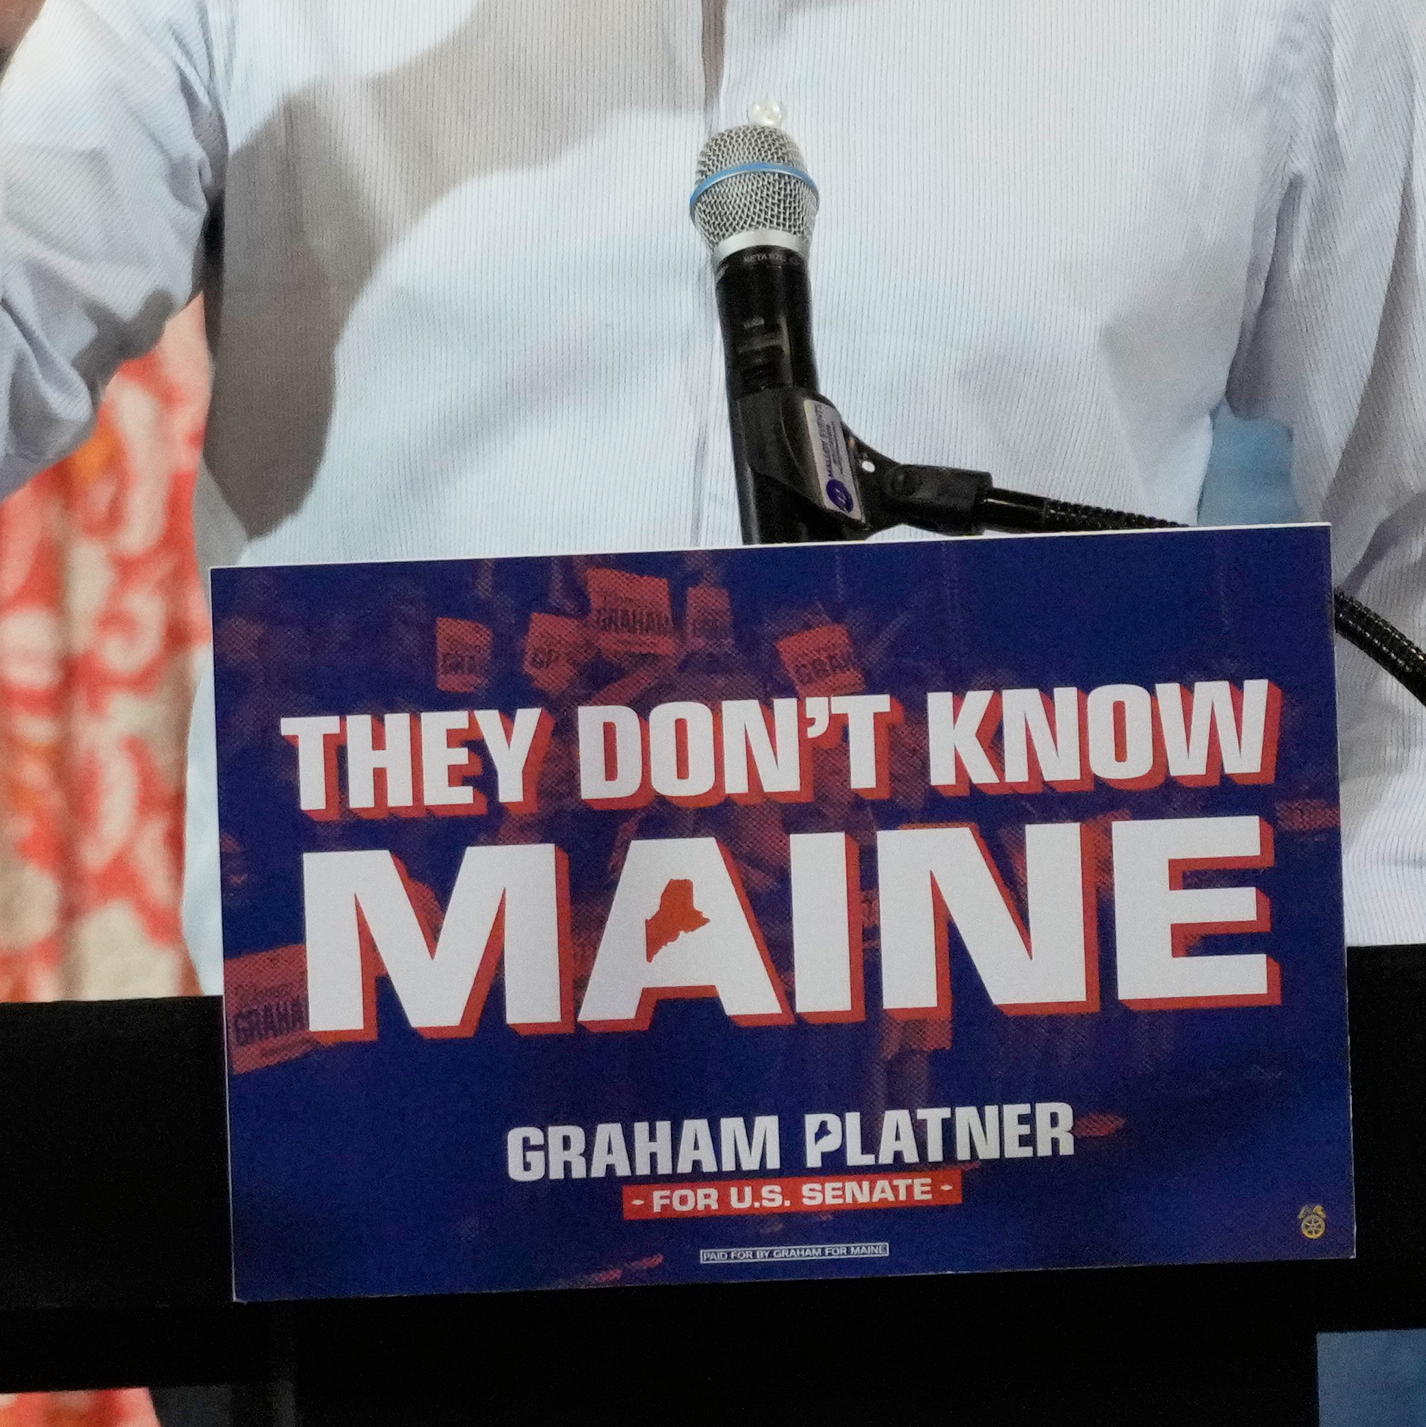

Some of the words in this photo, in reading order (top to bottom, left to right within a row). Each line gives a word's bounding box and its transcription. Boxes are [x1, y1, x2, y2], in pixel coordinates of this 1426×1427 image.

[280, 706, 545, 811] THEY
[577, 693, 893, 800] DON'T
[926, 678, 1271, 786] KNOW
[302, 815, 1273, 1033] MAINE
[507, 1115, 781, 1182] GRAHAM
[804, 1102, 1074, 1168] PLATNER
[652, 1188, 719, 1213] FOR
[730, 1184, 792, 1209] U.S.
[801, 1178, 933, 1206] SENATE
[703, 1251, 728, 1261] PAID
[731, 1250, 753, 1260] FOR
[756, 1249, 770, 1260] BY
[773, 1248, 822, 1258] GRAHAM
[825, 1247, 847, 1257] FOR
[850, 1245, 886, 1255] MAINE
